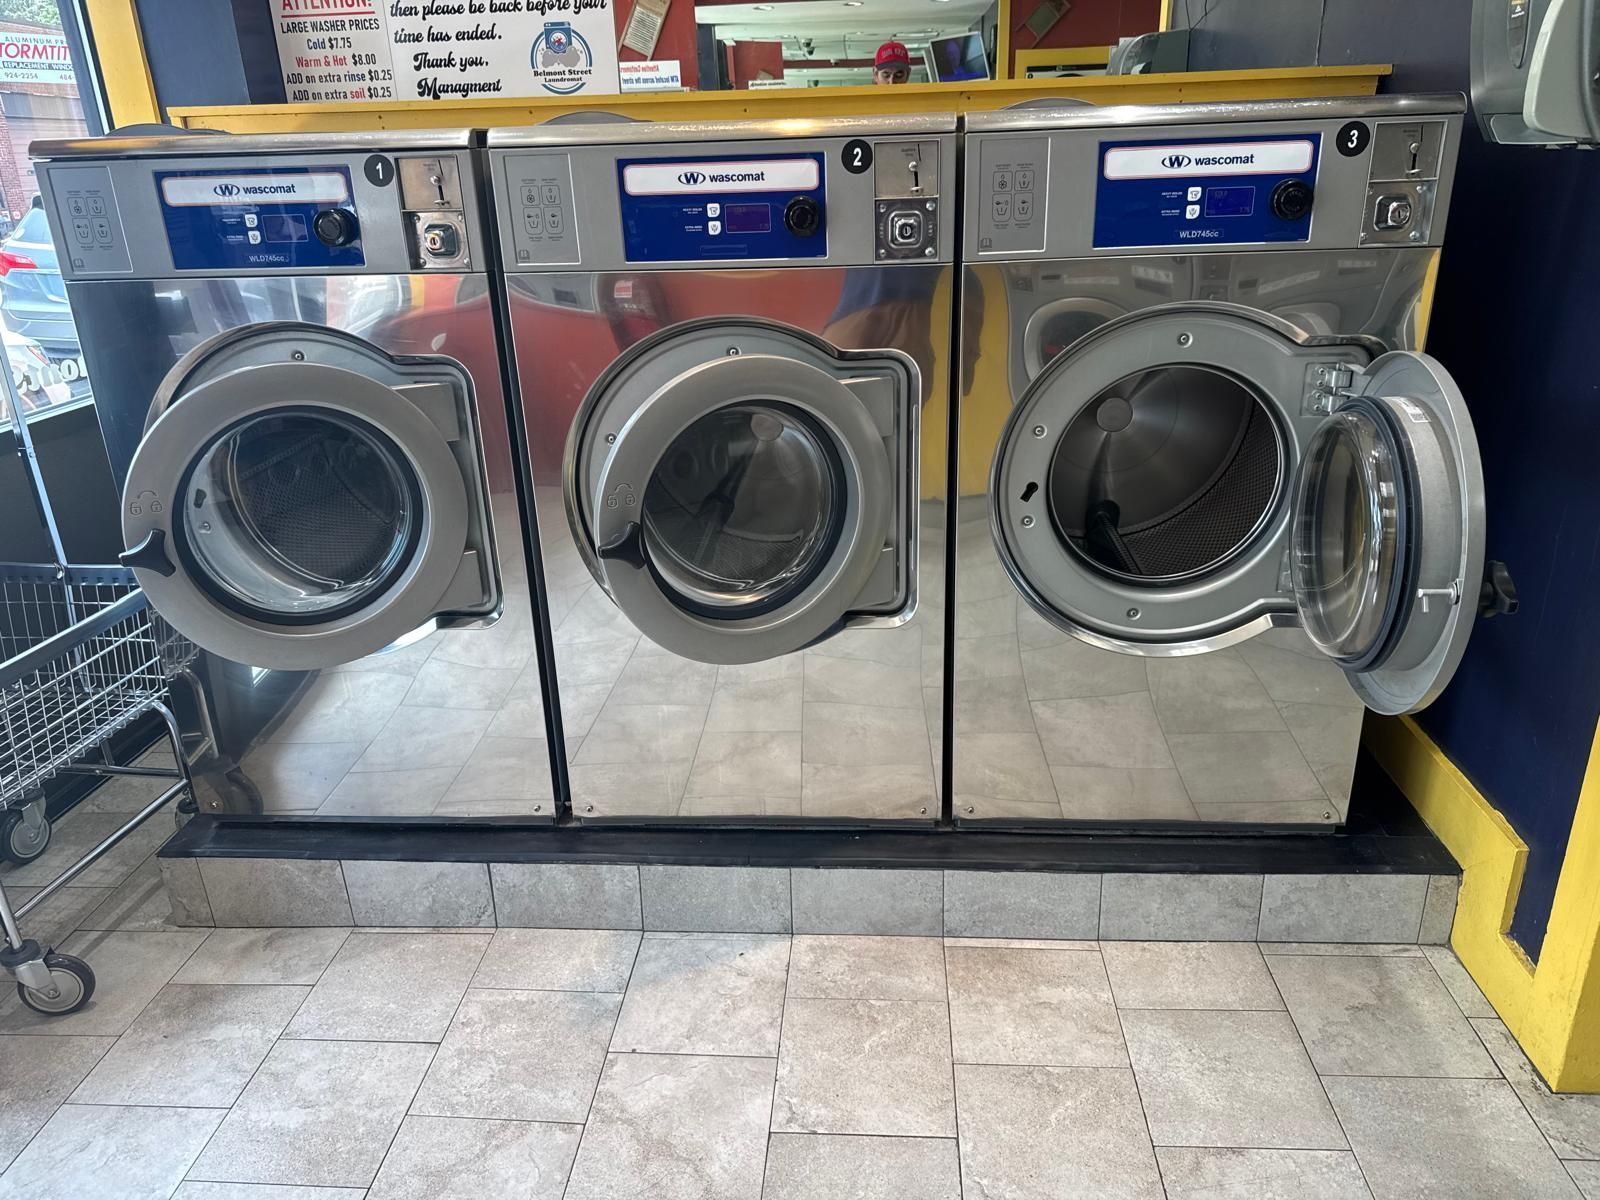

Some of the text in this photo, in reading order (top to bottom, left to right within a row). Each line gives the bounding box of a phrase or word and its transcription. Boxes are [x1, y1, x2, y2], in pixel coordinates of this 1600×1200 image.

[390, 0, 607, 21] then please be back before your
[280, 18, 380, 34] LARGE WASHER PRICES
[394, 23, 502, 44] time has ended.
[307, 37, 352, 50] Cold $7.75
[4, 62, 49, 70] REPLACEMENT
[296, 53, 376, 68] Warm & Hot $8.00
[413, 51, 457, 72] Thank
[286, 69, 392, 84] ADD on extra rinse $0.25
[293, 86, 392, 101] ADD on extra soil $0.25
[416, 77, 502, 100] Managment
[1348, 130, 1358, 148] 3
[853, 147, 862, 166] 2
[1195, 154, 1254, 165] wascomat
[376, 162, 383, 179] 1
[709, 171, 765, 183] wascomat
[242, 184, 296, 195] wascomat
[1179, 230, 1219, 239] WLD745cc
[249, 255, 285, 263] WLD745cc
